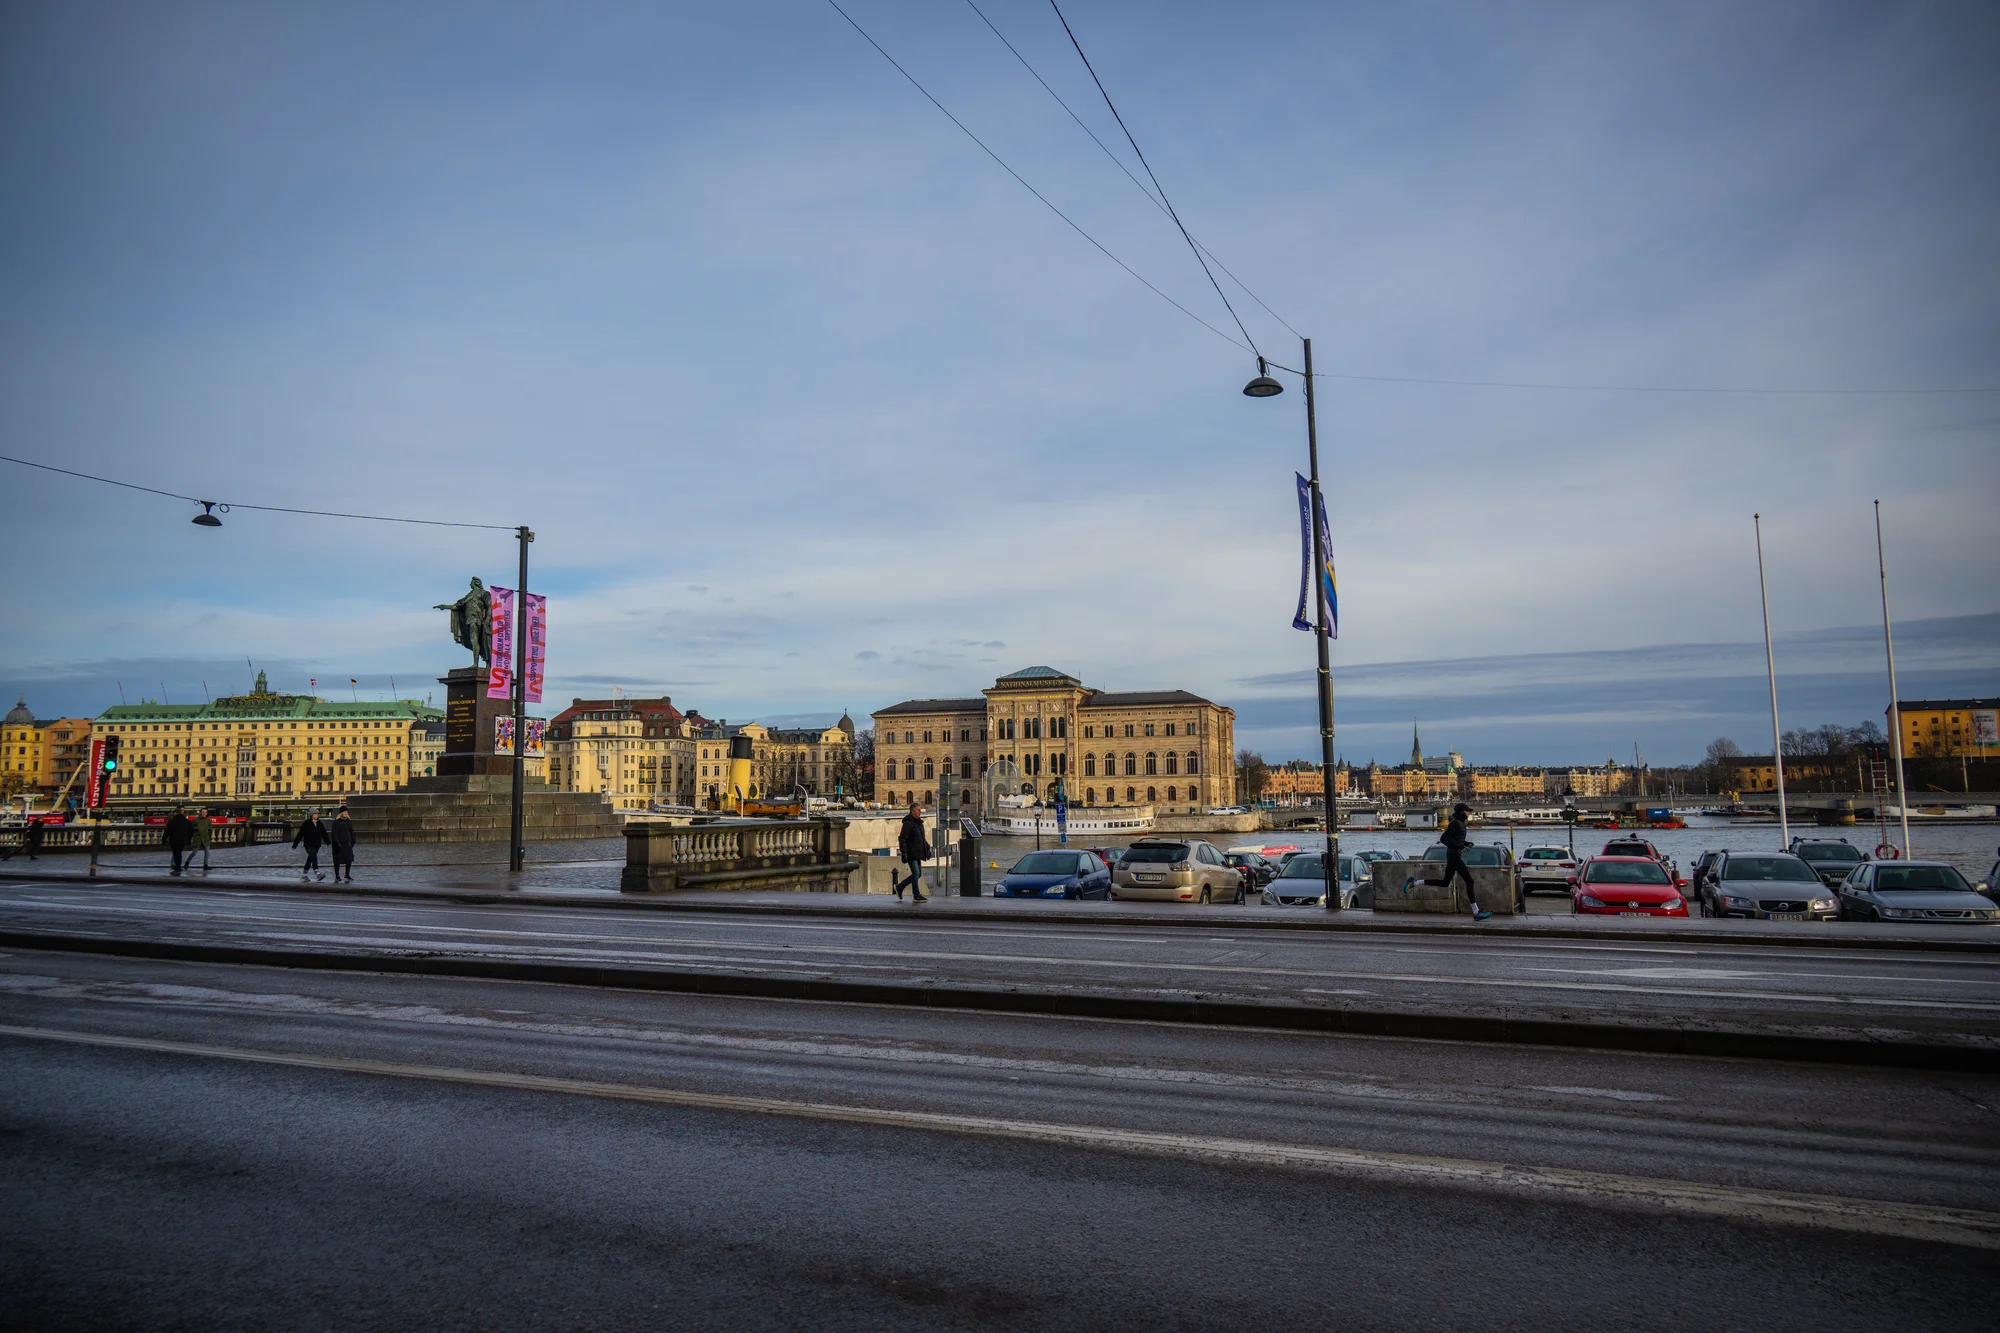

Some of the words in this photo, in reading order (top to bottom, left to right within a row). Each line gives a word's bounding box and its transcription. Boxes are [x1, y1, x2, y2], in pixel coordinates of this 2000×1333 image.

[531, 616, 540, 645] TOGETHER
[496, 637, 504, 668] STOCKHOLM
[530, 646, 539, 682] SUPPORTING
